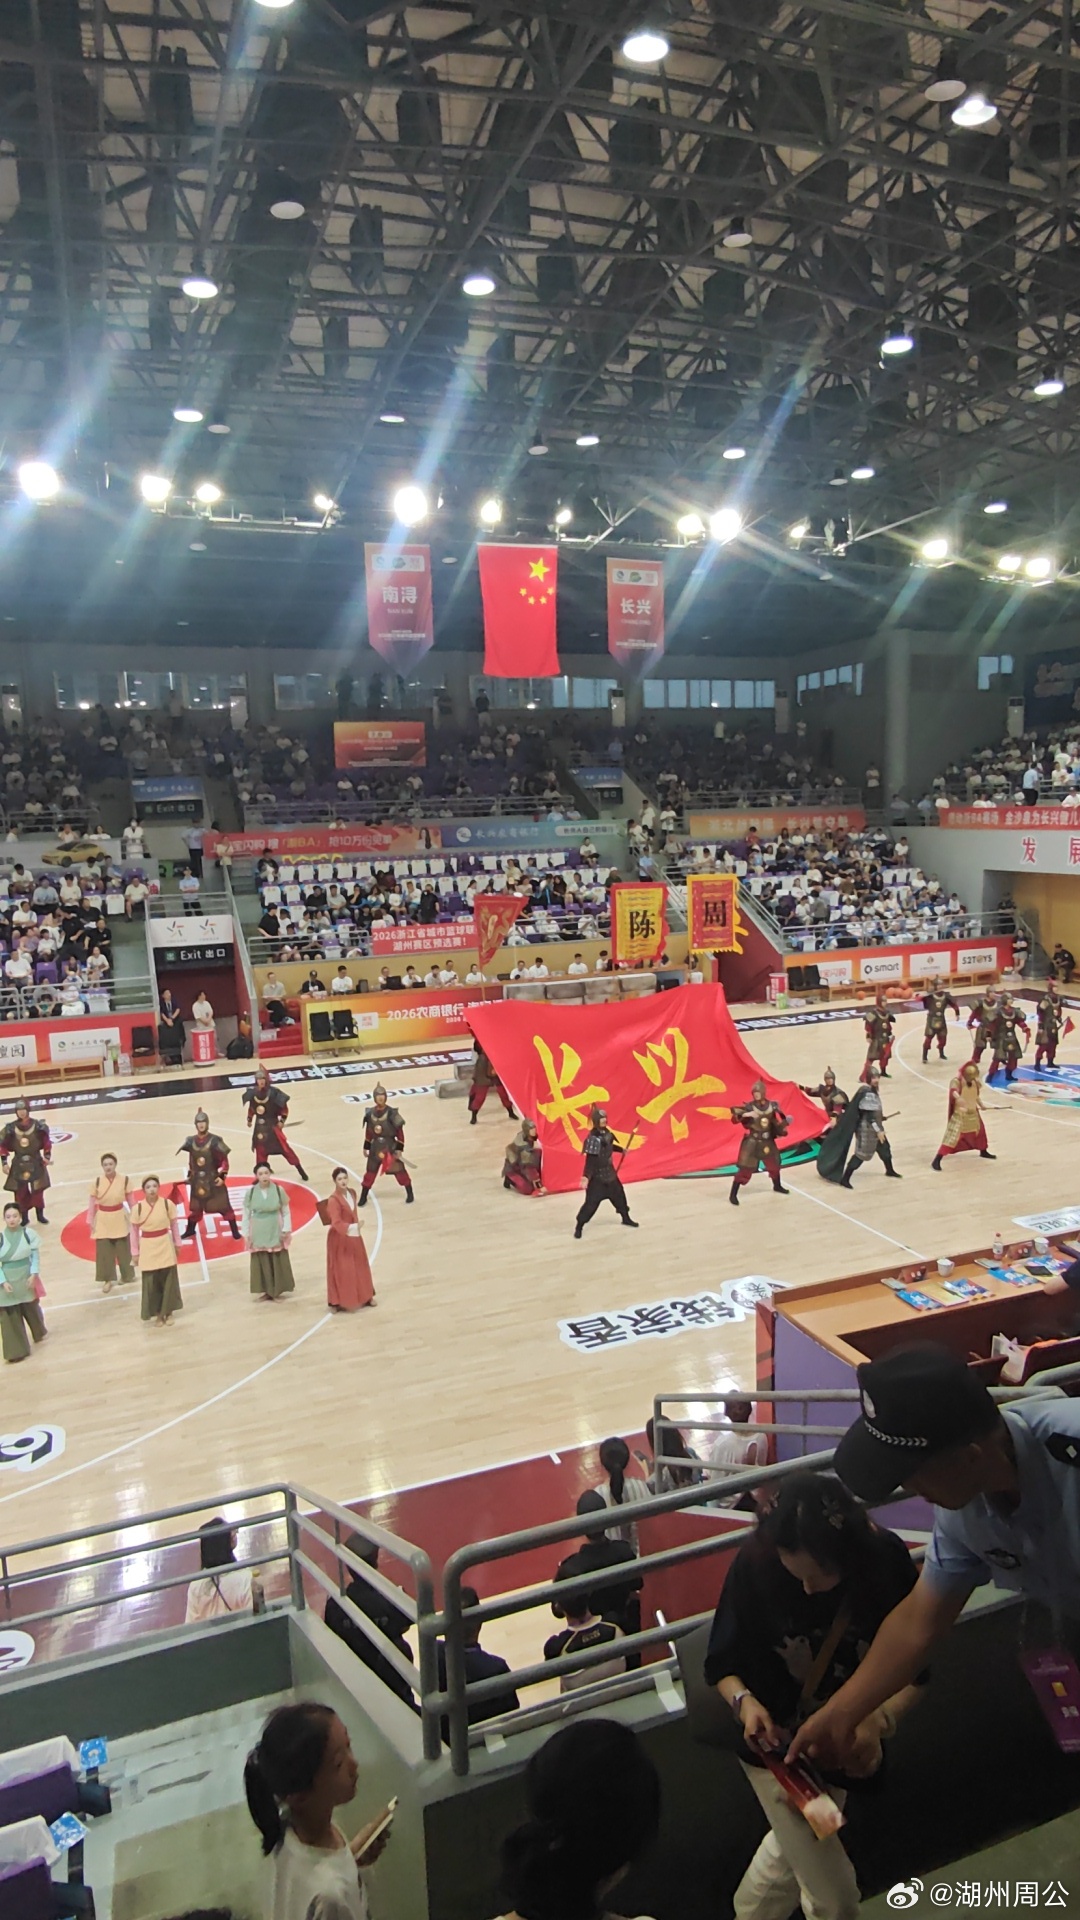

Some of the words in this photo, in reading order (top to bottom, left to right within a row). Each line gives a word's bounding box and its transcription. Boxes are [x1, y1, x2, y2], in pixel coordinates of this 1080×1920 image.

[382, 585, 417, 604] 南浔
[621, 597, 651, 615] 长兴
[156, 803, 175, 813] Exit
[704, 900, 726, 927] 周
[629, 910, 655, 939] 陈
[180, 949, 202, 960] Exit
[205, 948, 226, 958] 出口
[962, 954, 993, 965] 52TOYS
[874, 963, 900, 973] smart
[387, 1002, 465, 1021] 2026农商银行
[533, 1027, 732, 1153] 长兴
[566, 1295, 736, 1349] 钱家香
